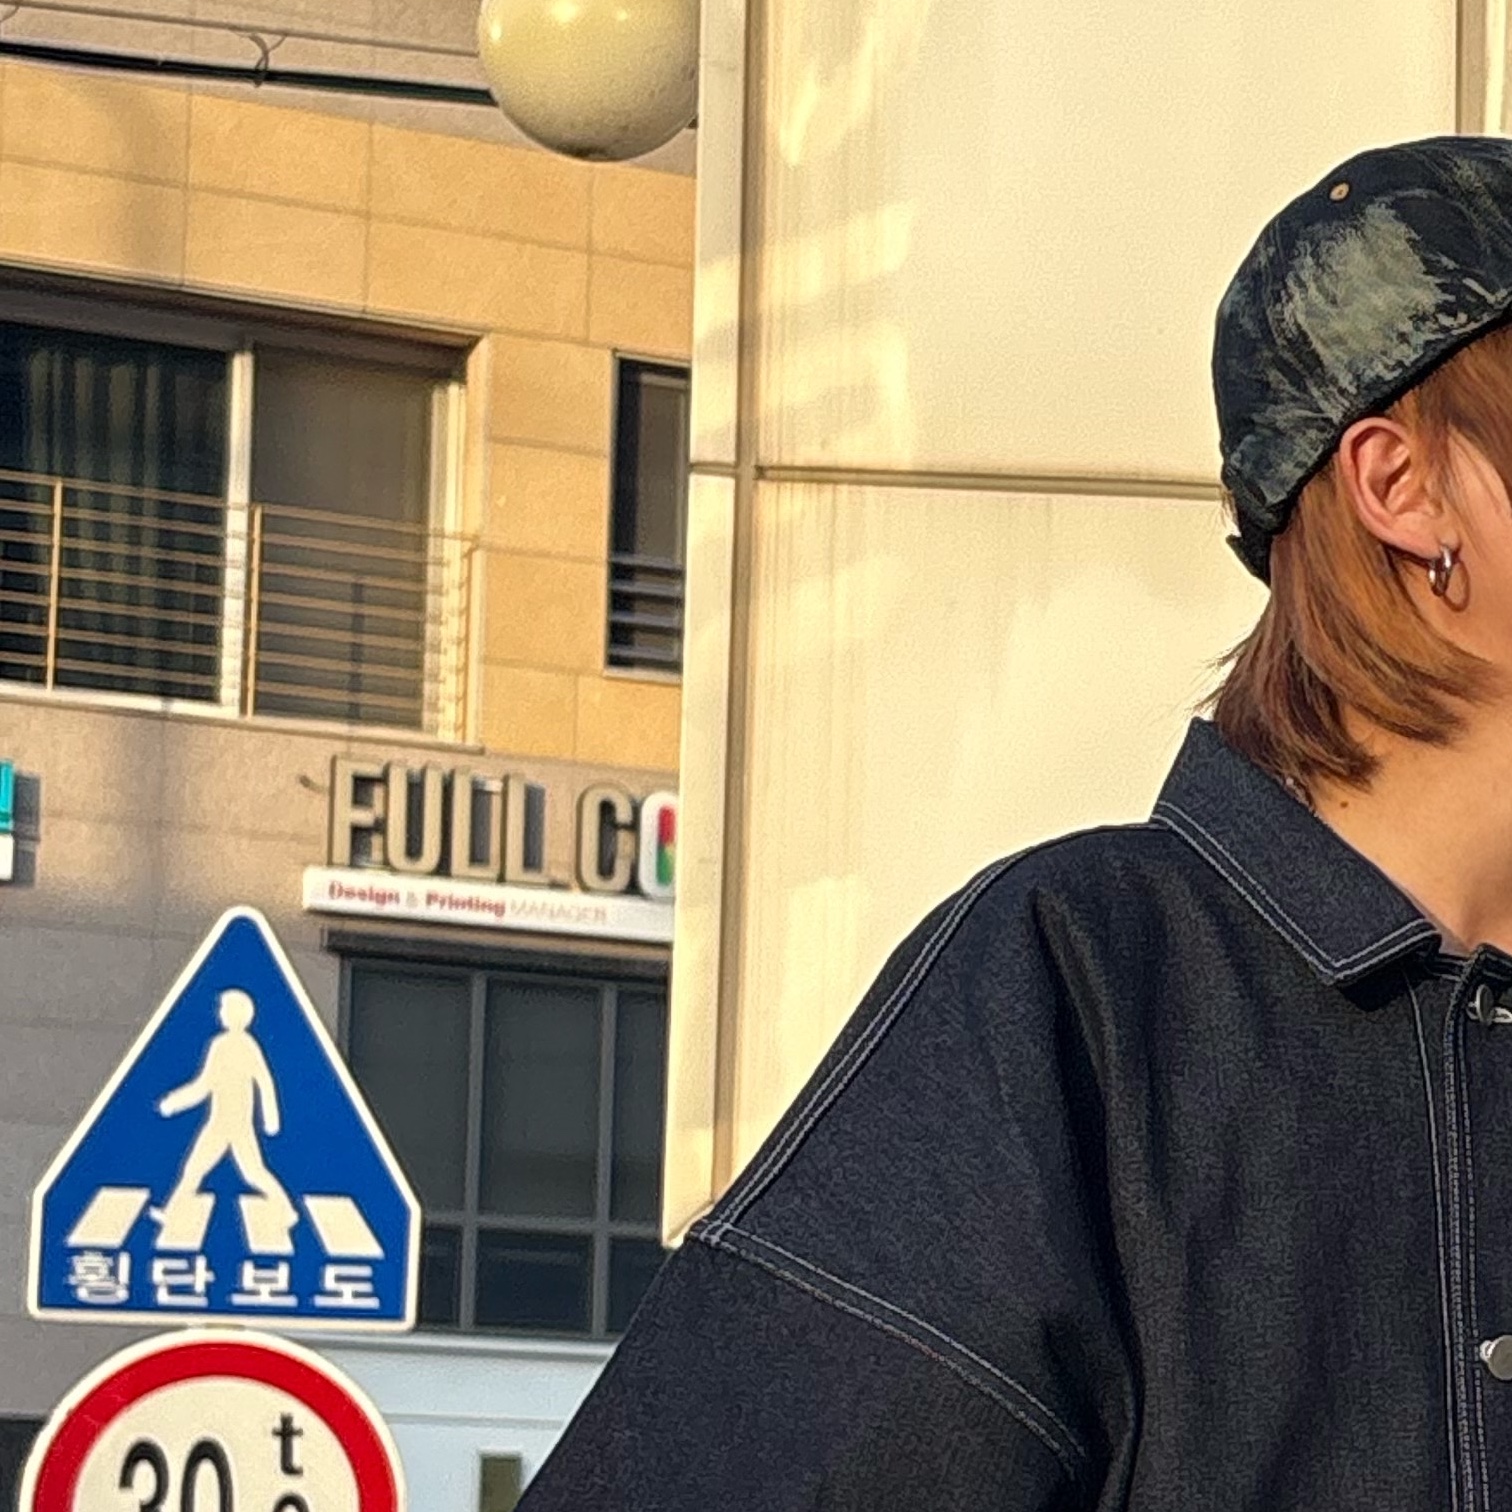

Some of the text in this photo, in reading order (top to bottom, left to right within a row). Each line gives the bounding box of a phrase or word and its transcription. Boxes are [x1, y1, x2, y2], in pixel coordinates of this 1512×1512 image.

[328, 880, 400, 907] Design
[425, 889, 506, 919] Printing
[69, 1250, 381, 1309] 횡단보도
[271, 1412, 304, 1477] t
